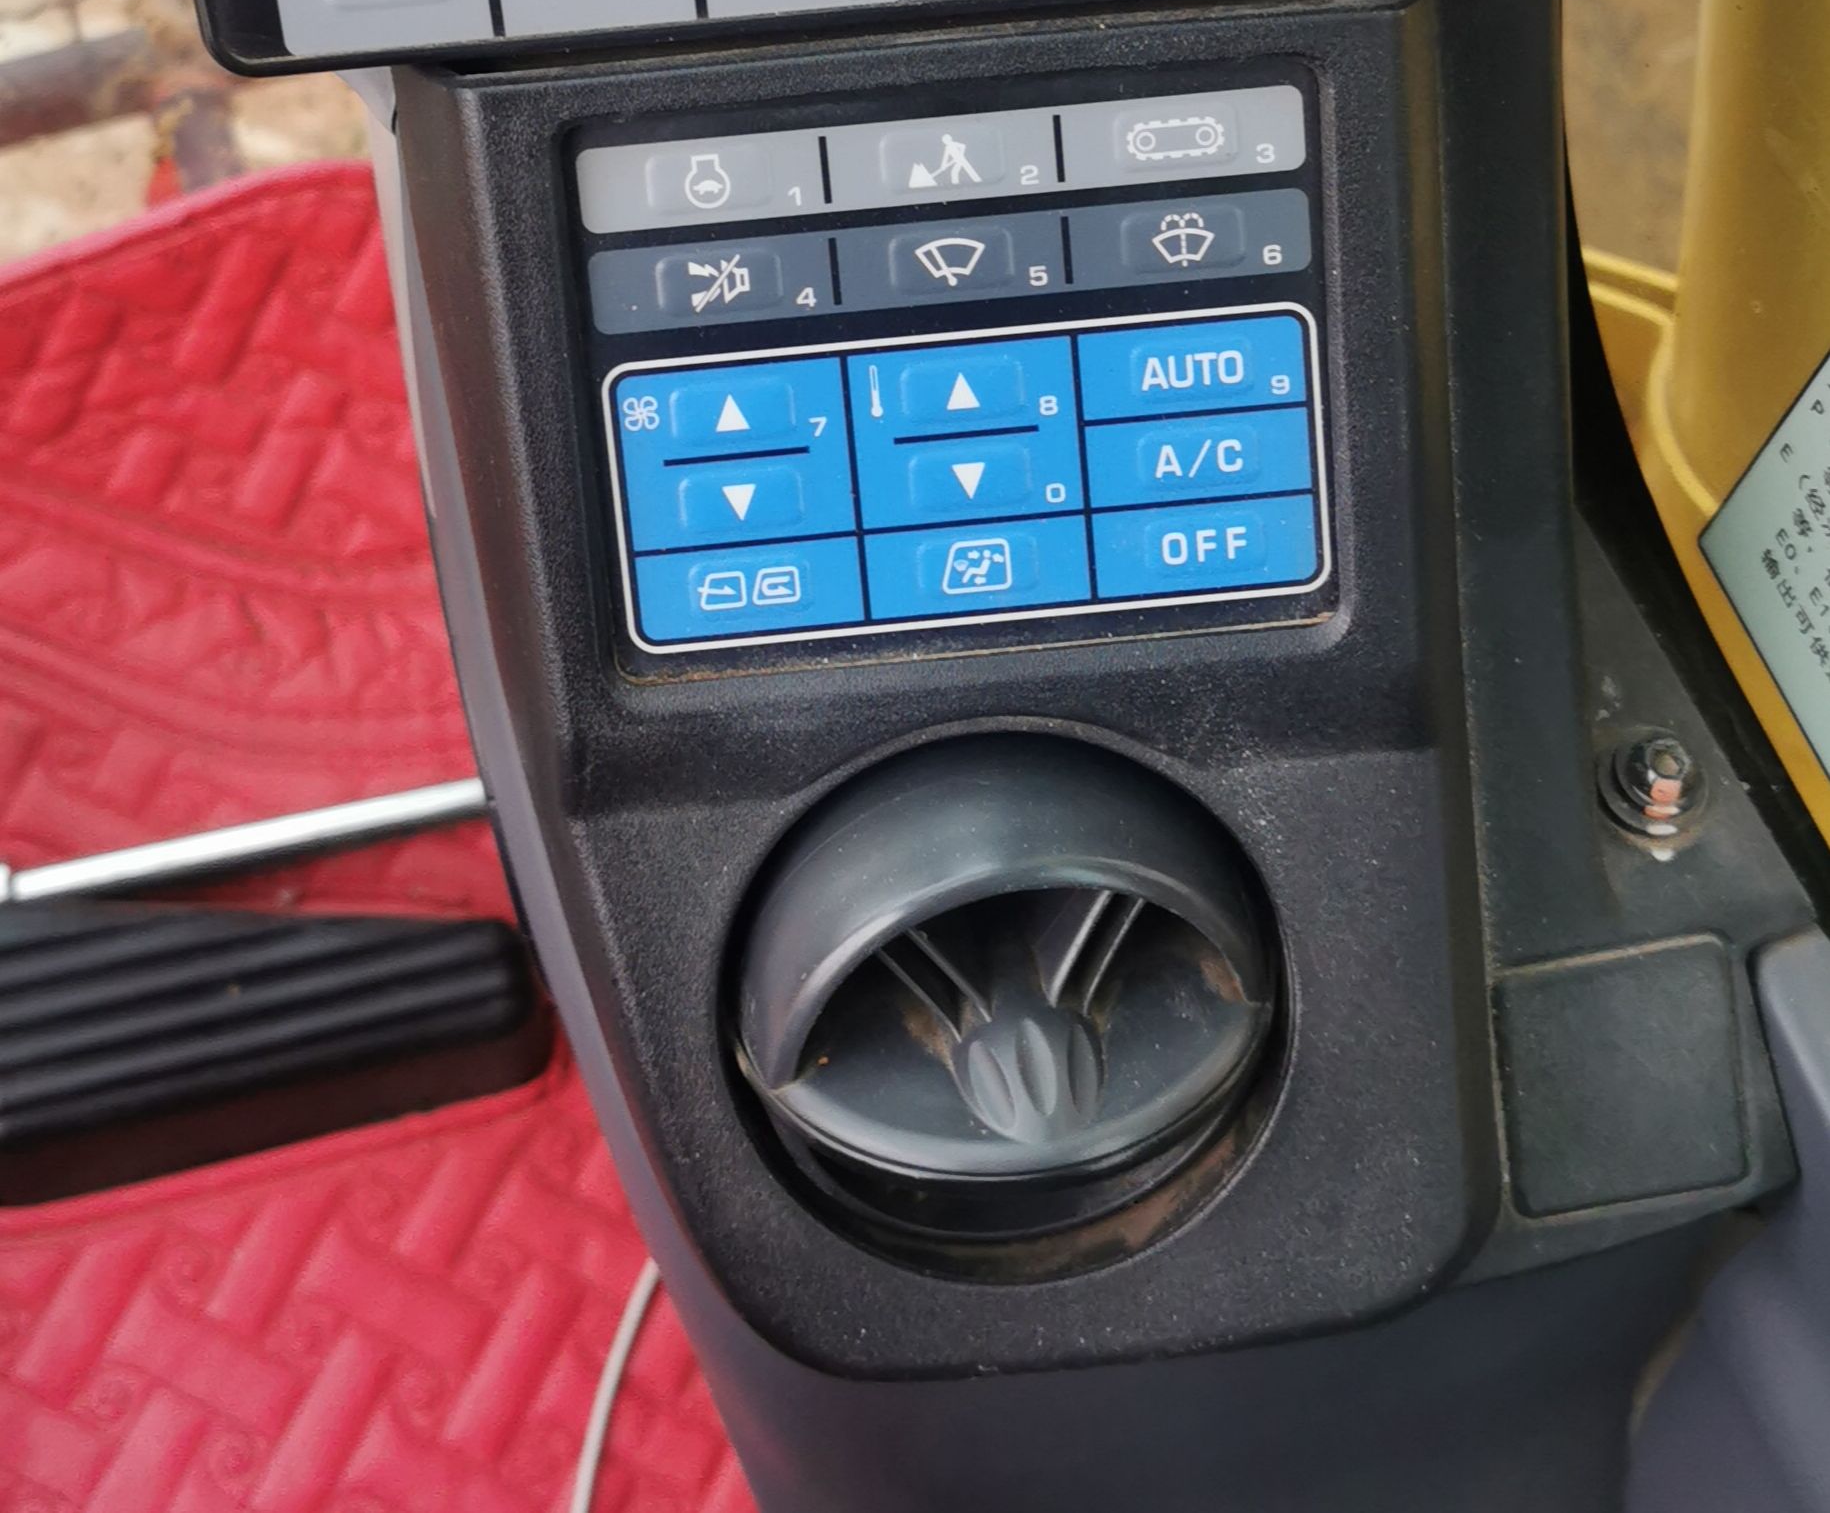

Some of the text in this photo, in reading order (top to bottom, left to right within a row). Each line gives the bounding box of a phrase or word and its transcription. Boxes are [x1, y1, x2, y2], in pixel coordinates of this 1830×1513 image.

[1256, 143, 1276, 164] 3
[1020, 164, 1039, 186] 2
[788, 186, 802, 206] 1
[1262, 244, 1283, 265] 6
[1029, 265, 1049, 287] 5
[796, 287, 817, 307] 4
[1141, 350, 1244, 391] AUTO
[1270, 374, 1290, 395] 9
[1039, 395, 1059, 416] 8
[1810, 399, 1825, 415] P
[809, 416, 827, 437] 7
[1155, 439, 1243, 479] A/C
[1780, 443, 1794, 463] E
[1161, 526, 1247, 566] OFF
